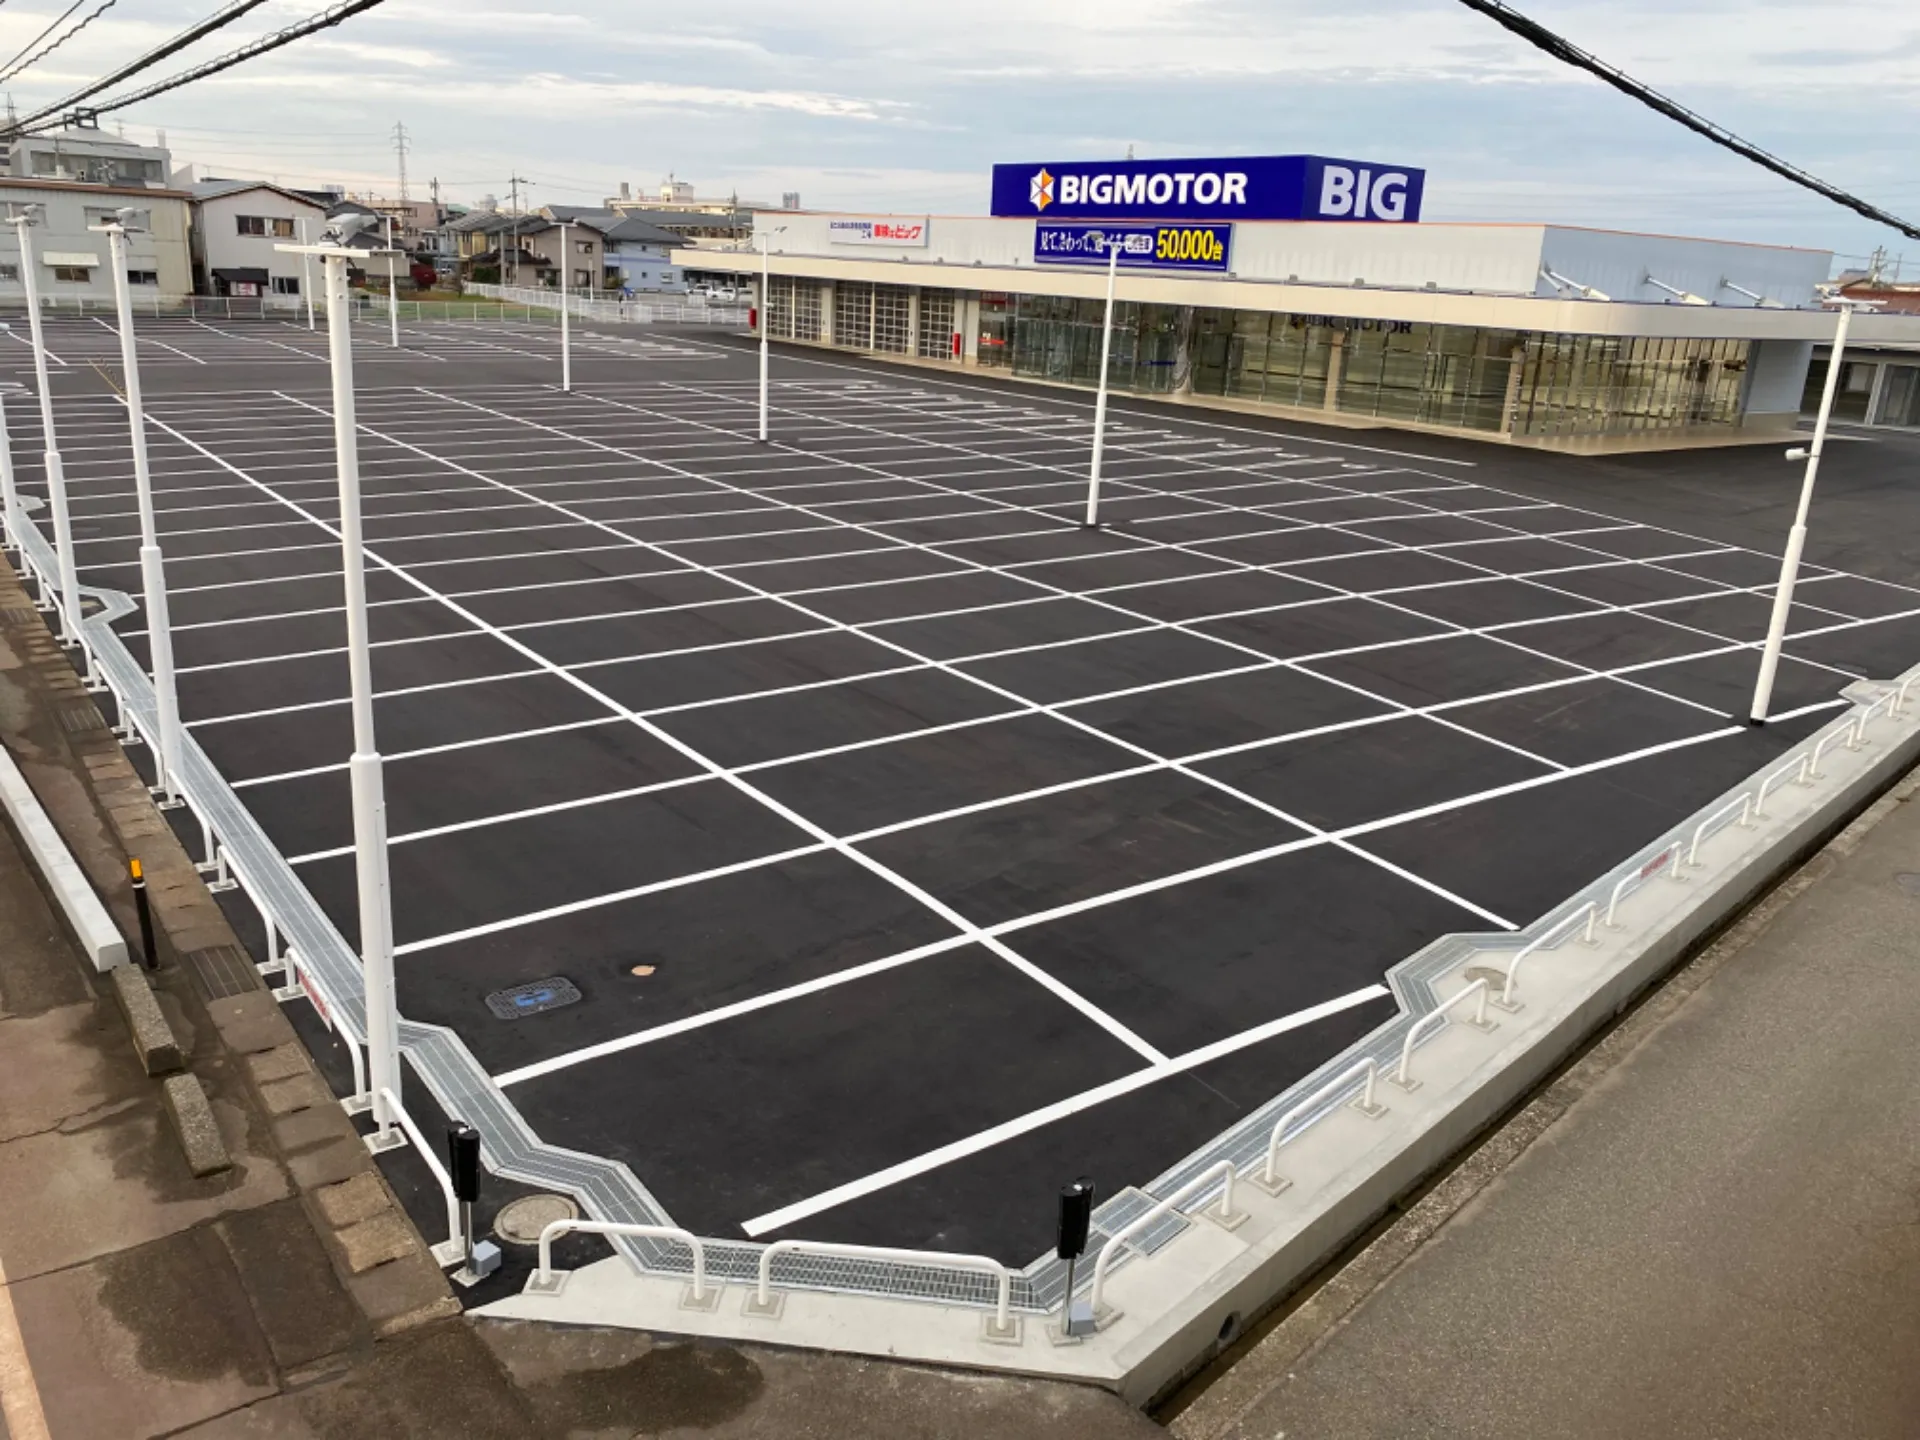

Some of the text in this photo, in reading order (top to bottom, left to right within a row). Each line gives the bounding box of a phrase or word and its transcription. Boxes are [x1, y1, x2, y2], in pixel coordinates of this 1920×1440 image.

[1060, 172, 1247, 205] BIGMOTOR
[1318, 165, 1409, 222] BIG
[1156, 229, 1223, 260] 50,000台
